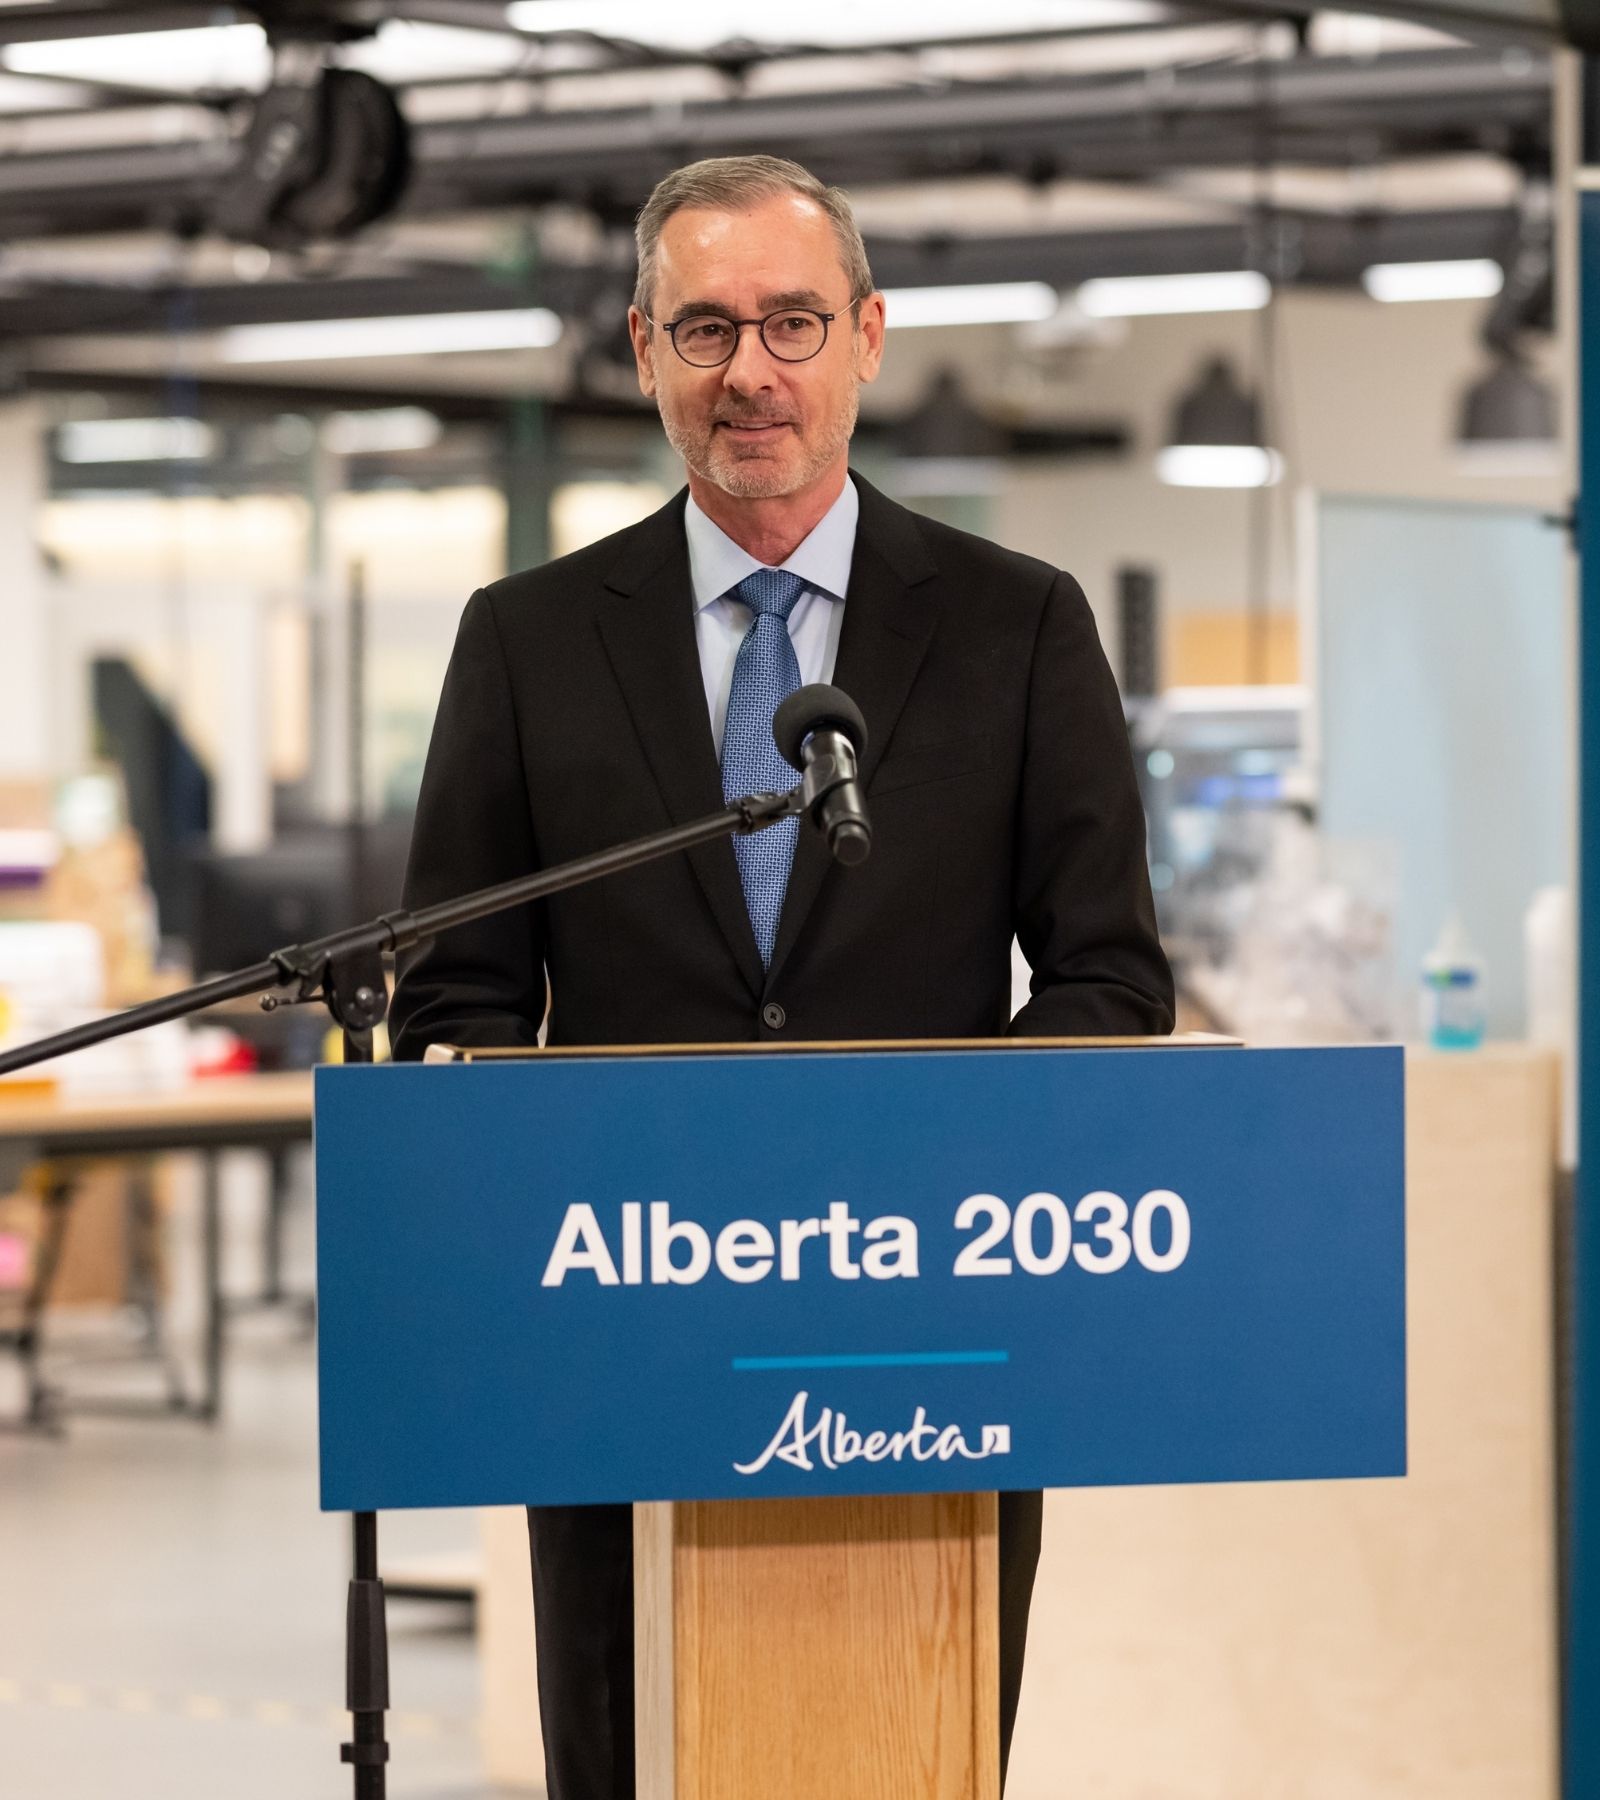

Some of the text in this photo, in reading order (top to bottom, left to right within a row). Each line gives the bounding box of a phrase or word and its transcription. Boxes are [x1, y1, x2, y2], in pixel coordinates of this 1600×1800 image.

[542, 1188, 1190, 1286] Alberta 2030
[733, 1390, 993, 1475] Alberta
